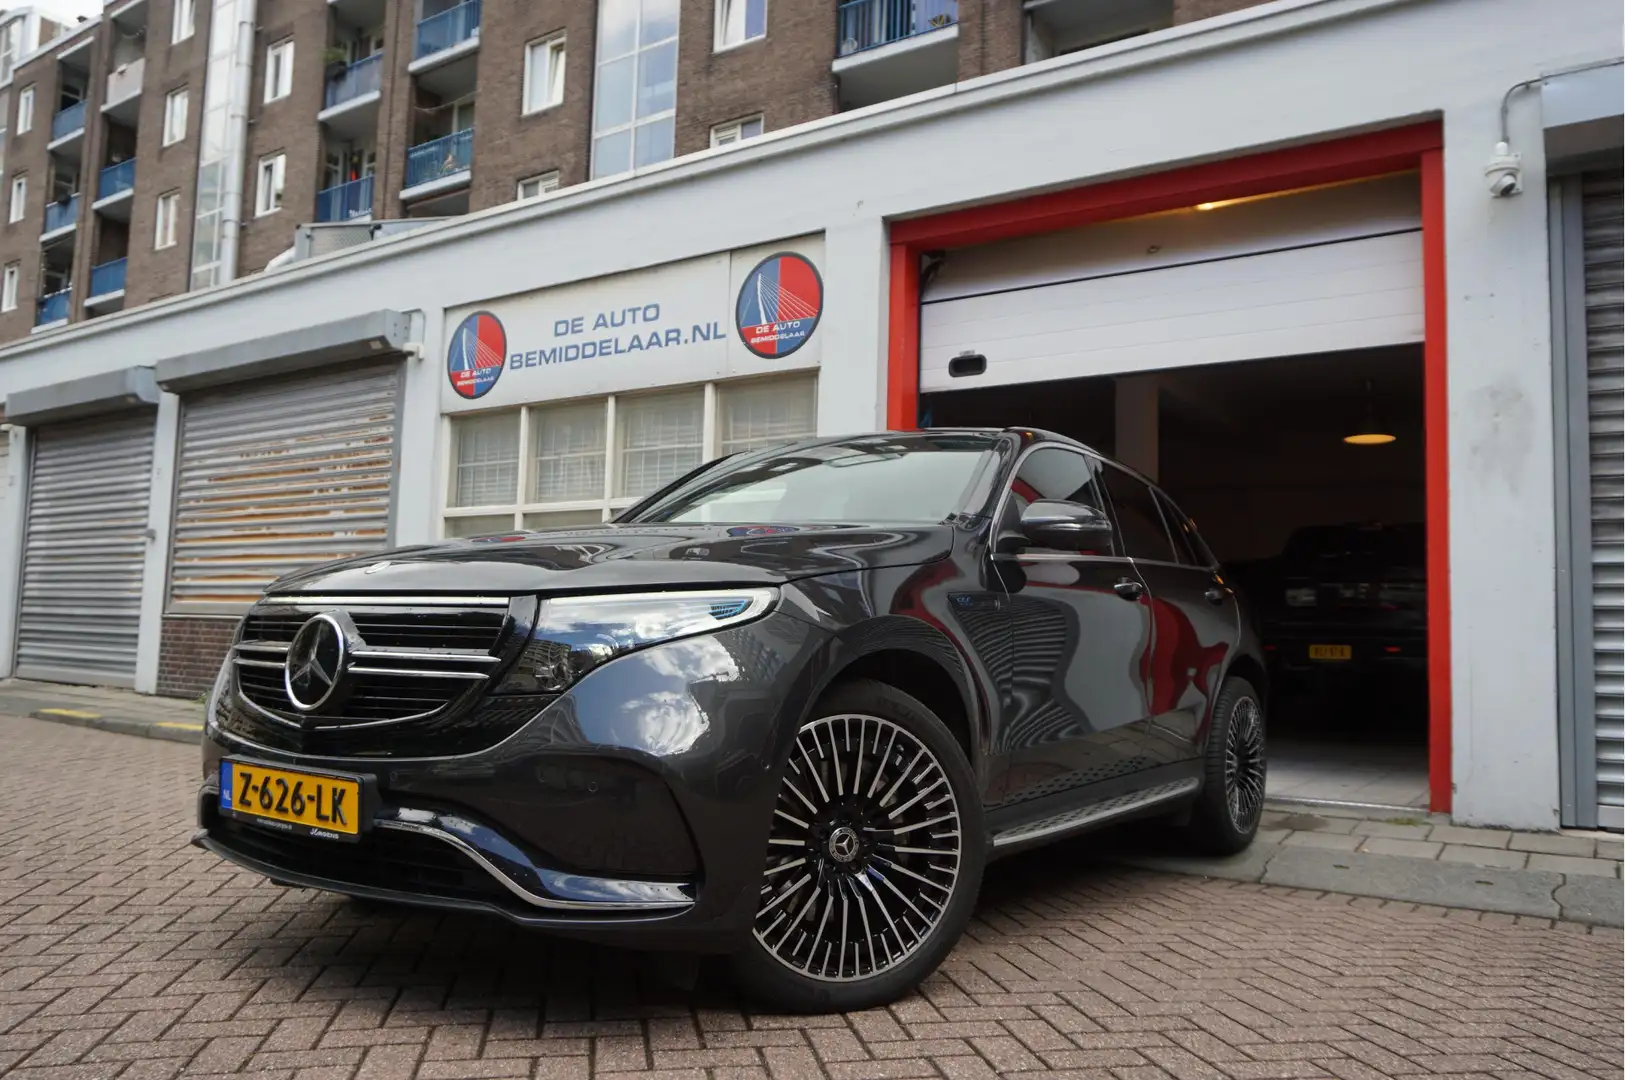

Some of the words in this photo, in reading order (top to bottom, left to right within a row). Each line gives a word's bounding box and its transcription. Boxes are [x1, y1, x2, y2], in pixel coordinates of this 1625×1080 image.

[553, 316, 584, 338] DE
[592, 303, 660, 331] AUTO
[755, 325, 770, 335] DE
[772, 320, 801, 332] AUTO
[750, 330, 805, 344] BEMIDDELAAR
[509, 321, 727, 370] BEMIDDELAAR.NL
[472, 367, 492, 377] AUTO
[222, 789, 231, 801] NL
[238, 771, 348, 826] Z-626-LK
